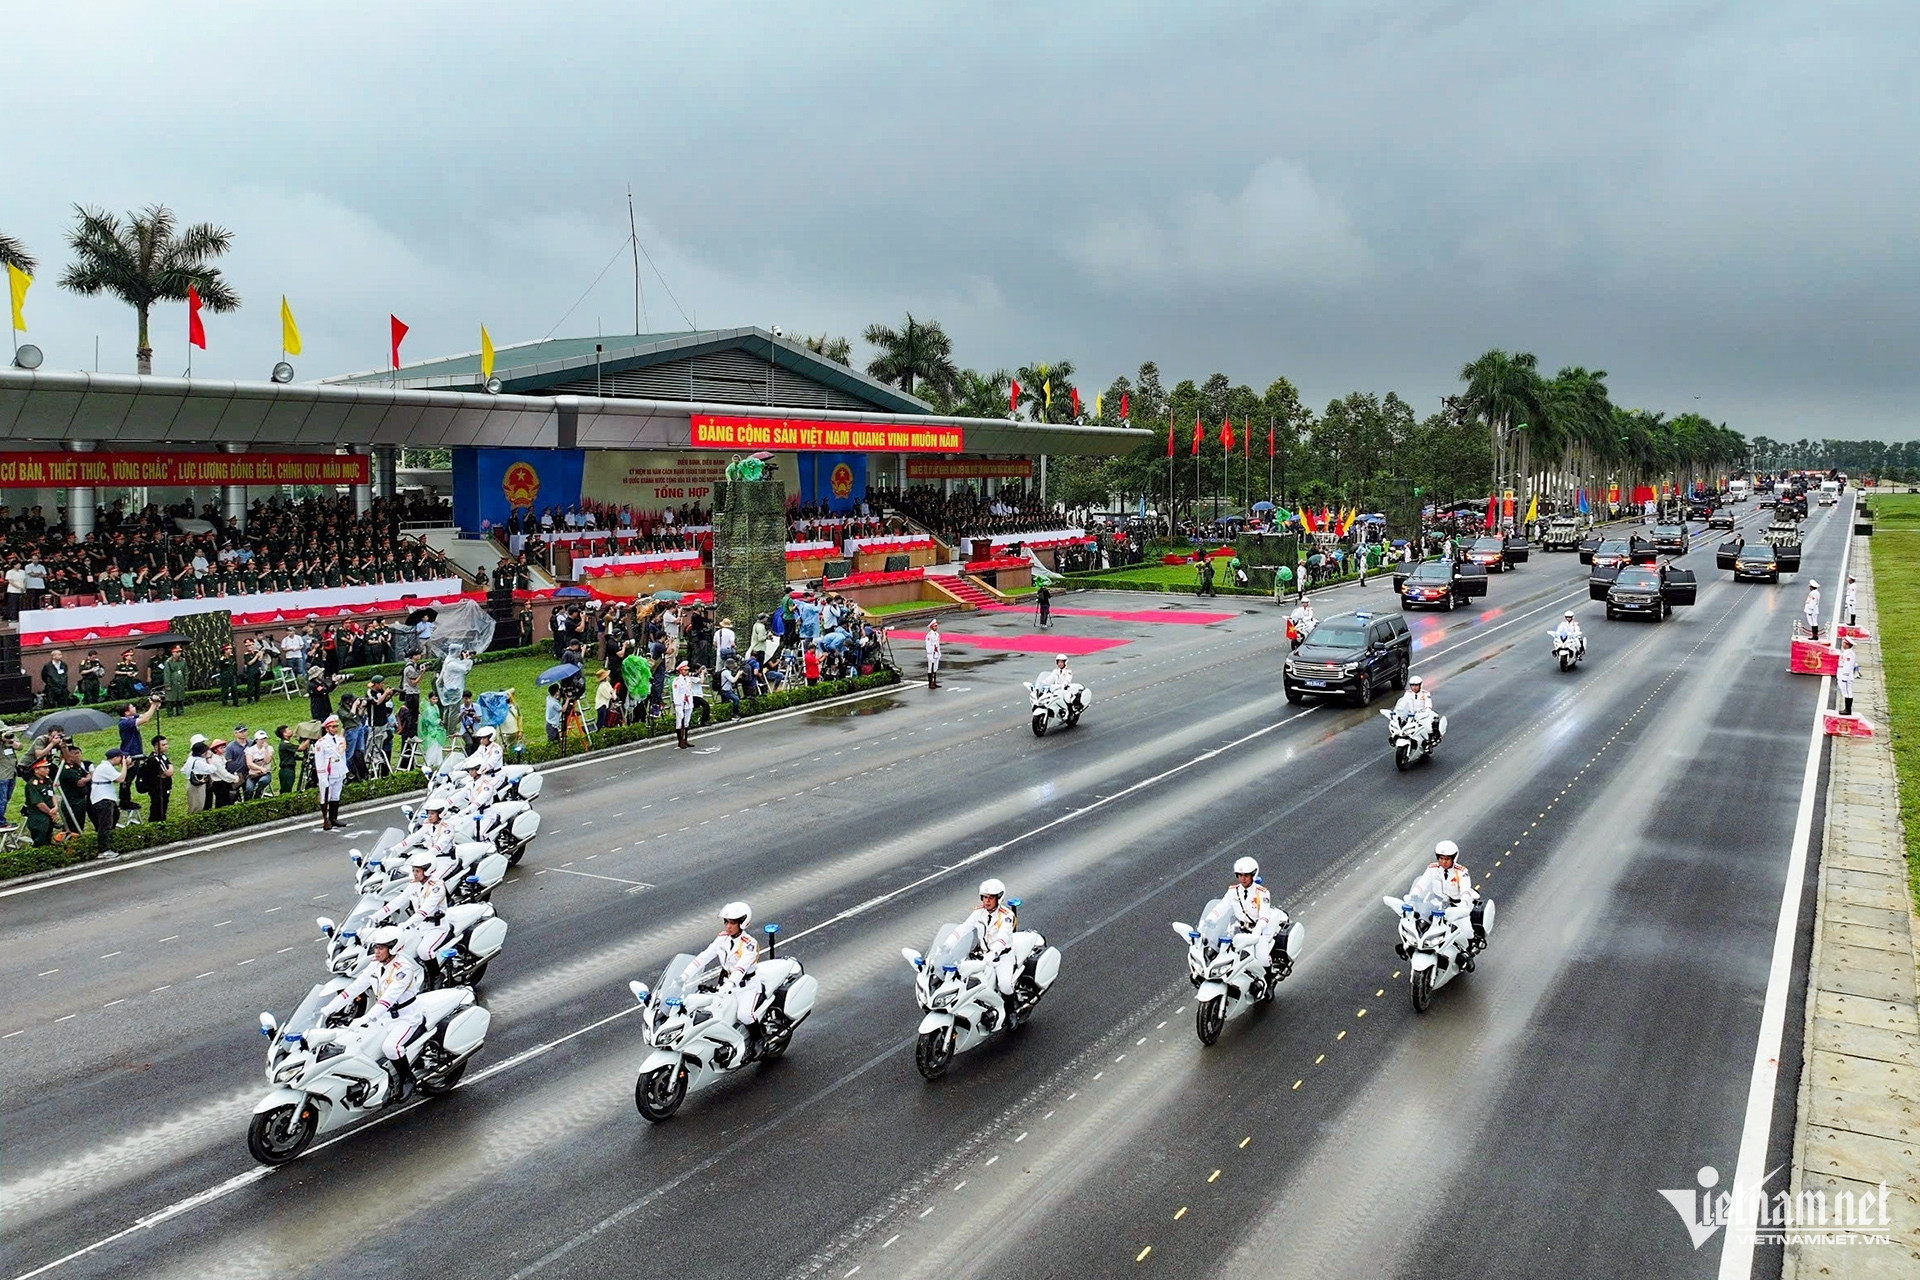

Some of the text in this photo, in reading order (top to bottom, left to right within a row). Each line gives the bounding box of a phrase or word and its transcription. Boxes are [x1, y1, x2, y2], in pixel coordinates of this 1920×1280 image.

[698, 418, 959, 448] ĐẢNG CỘNG SẢN VIỆT NAM QUANG VINH MUÔN NĂM
[1, 461, 16, 482] CƠ
[20, 457, 46, 483] BẢN,
[49, 457, 77, 481] THIẾT
[81, 460, 110, 484] THỰC,
[179, 461, 196, 483] LỰC
[200, 461, 228, 483] LƯỢNG
[278, 460, 303, 479] CHÍNH
[304, 462, 321, 481] QUY,
[343, 461, 359, 482] MỰC
[654, 485, 710, 500] TỔNG HỢP
